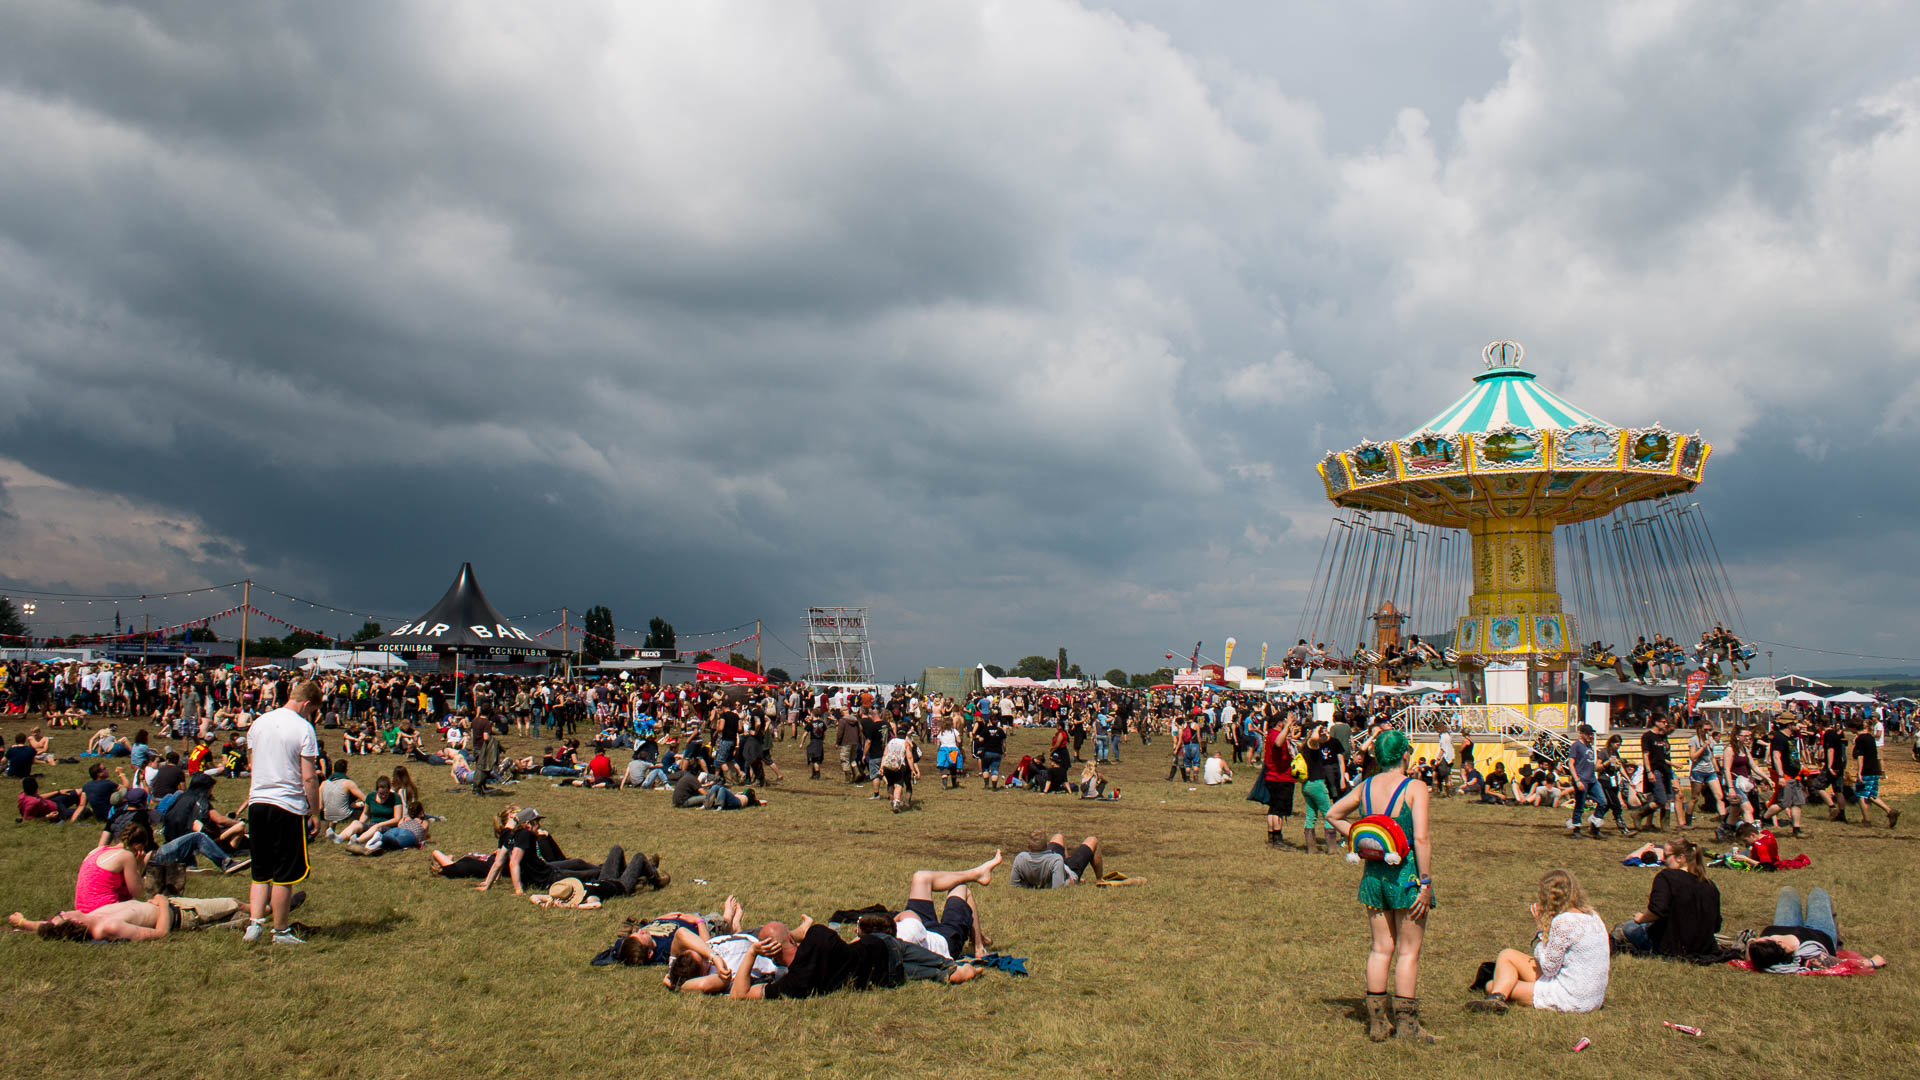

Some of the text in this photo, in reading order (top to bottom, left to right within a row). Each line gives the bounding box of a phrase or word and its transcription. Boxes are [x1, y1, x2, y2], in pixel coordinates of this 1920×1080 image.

[390, 621, 451, 637] BAR
[469, 623, 534, 641] BAR
[378, 644, 433, 652] COCKTAILBAR
[489, 647, 547, 656] COCKTAILBAR
